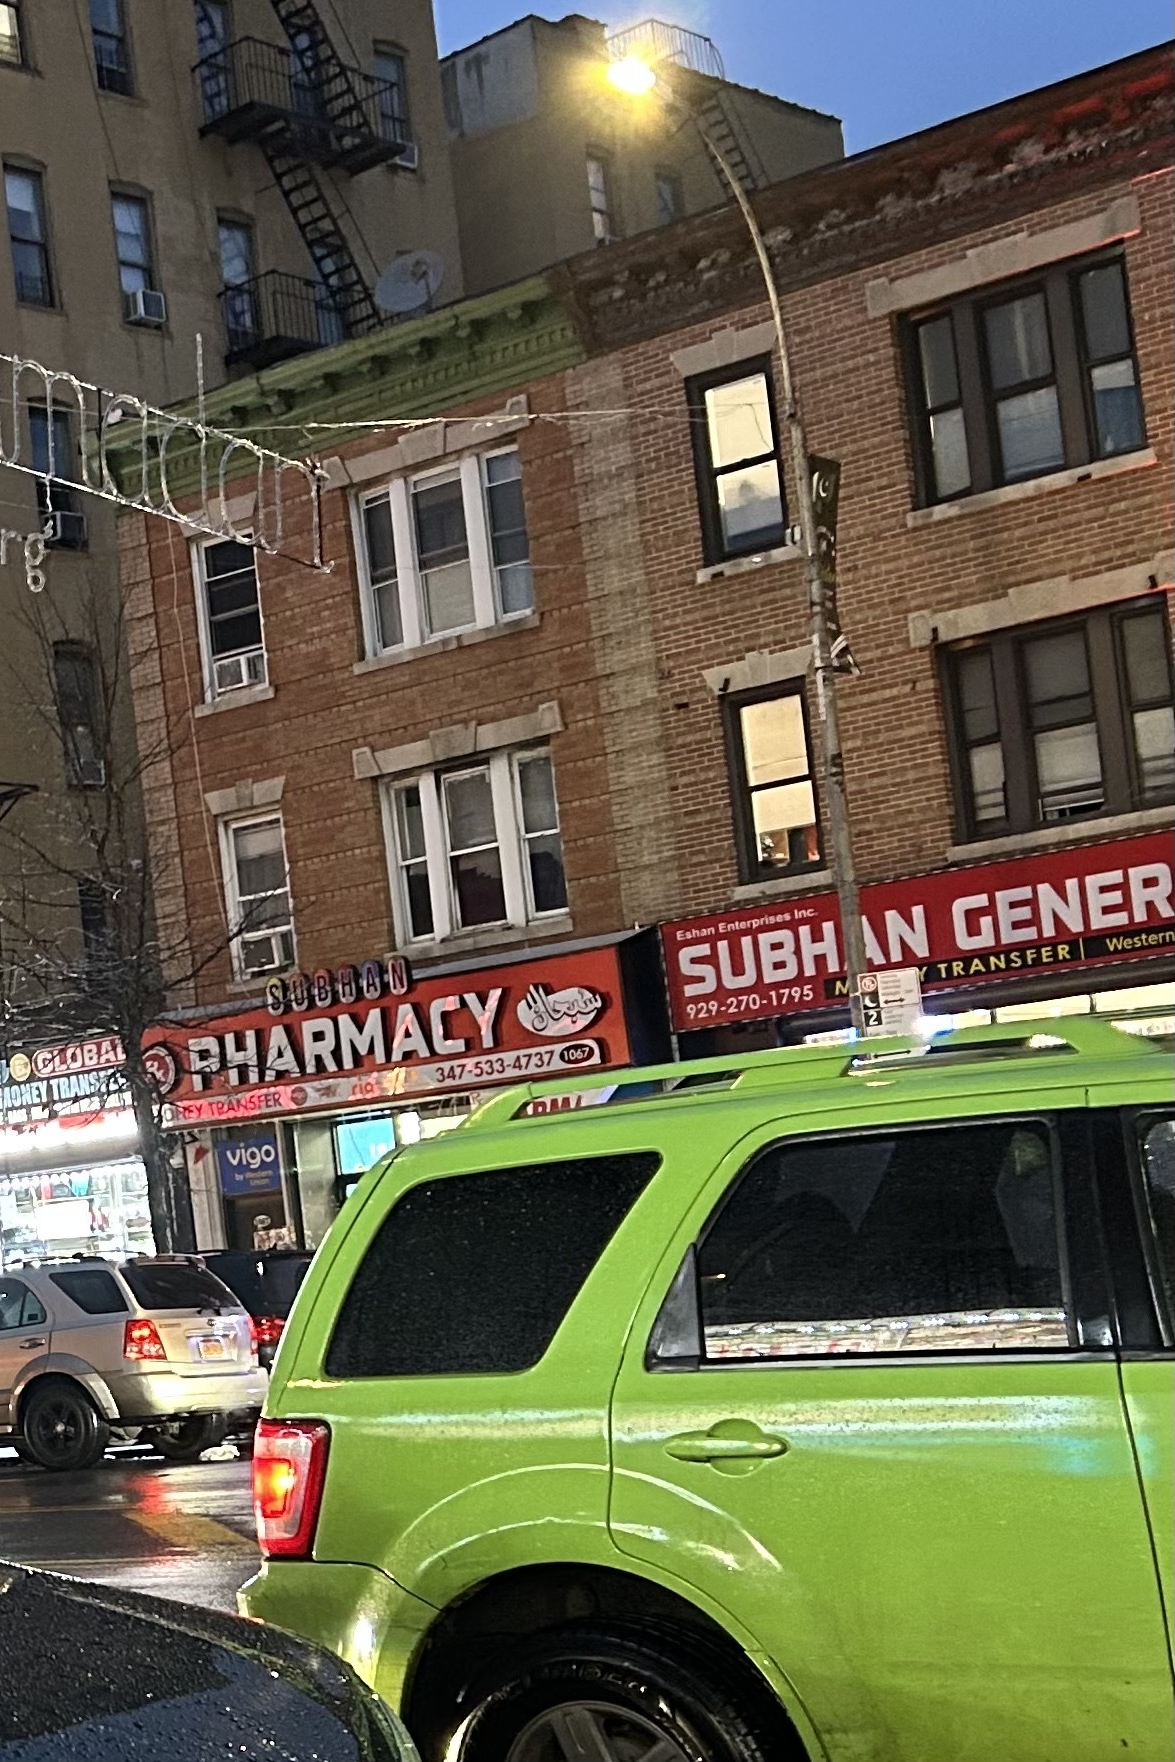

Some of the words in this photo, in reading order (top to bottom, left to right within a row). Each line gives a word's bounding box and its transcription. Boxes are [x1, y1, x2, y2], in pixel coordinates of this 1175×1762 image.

[952, 862, 1175, 950] GENER
[676, 922, 715, 941] Eshan
[718, 912, 791, 934] Enterprises
[794, 907, 818, 919] Inc.
[678, 904, 929, 998] SUBHAN
[938, 945, 1070, 979] TRANSFER
[268, 961, 405, 1012] SUBHAN
[687, 985, 813, 1019] 929-270-1795
[868, 1011, 878, 1025] 2
[37, 1039, 126, 1074] GLOBAL
[188, 988, 503, 1091] PHARMACY
[563, 1047, 589, 1061] 1067
[436, 1051, 554, 1082] 347-533-4737
[208, 1093, 281, 1118] TRANSFER
[226, 1143, 276, 1169] vigo
